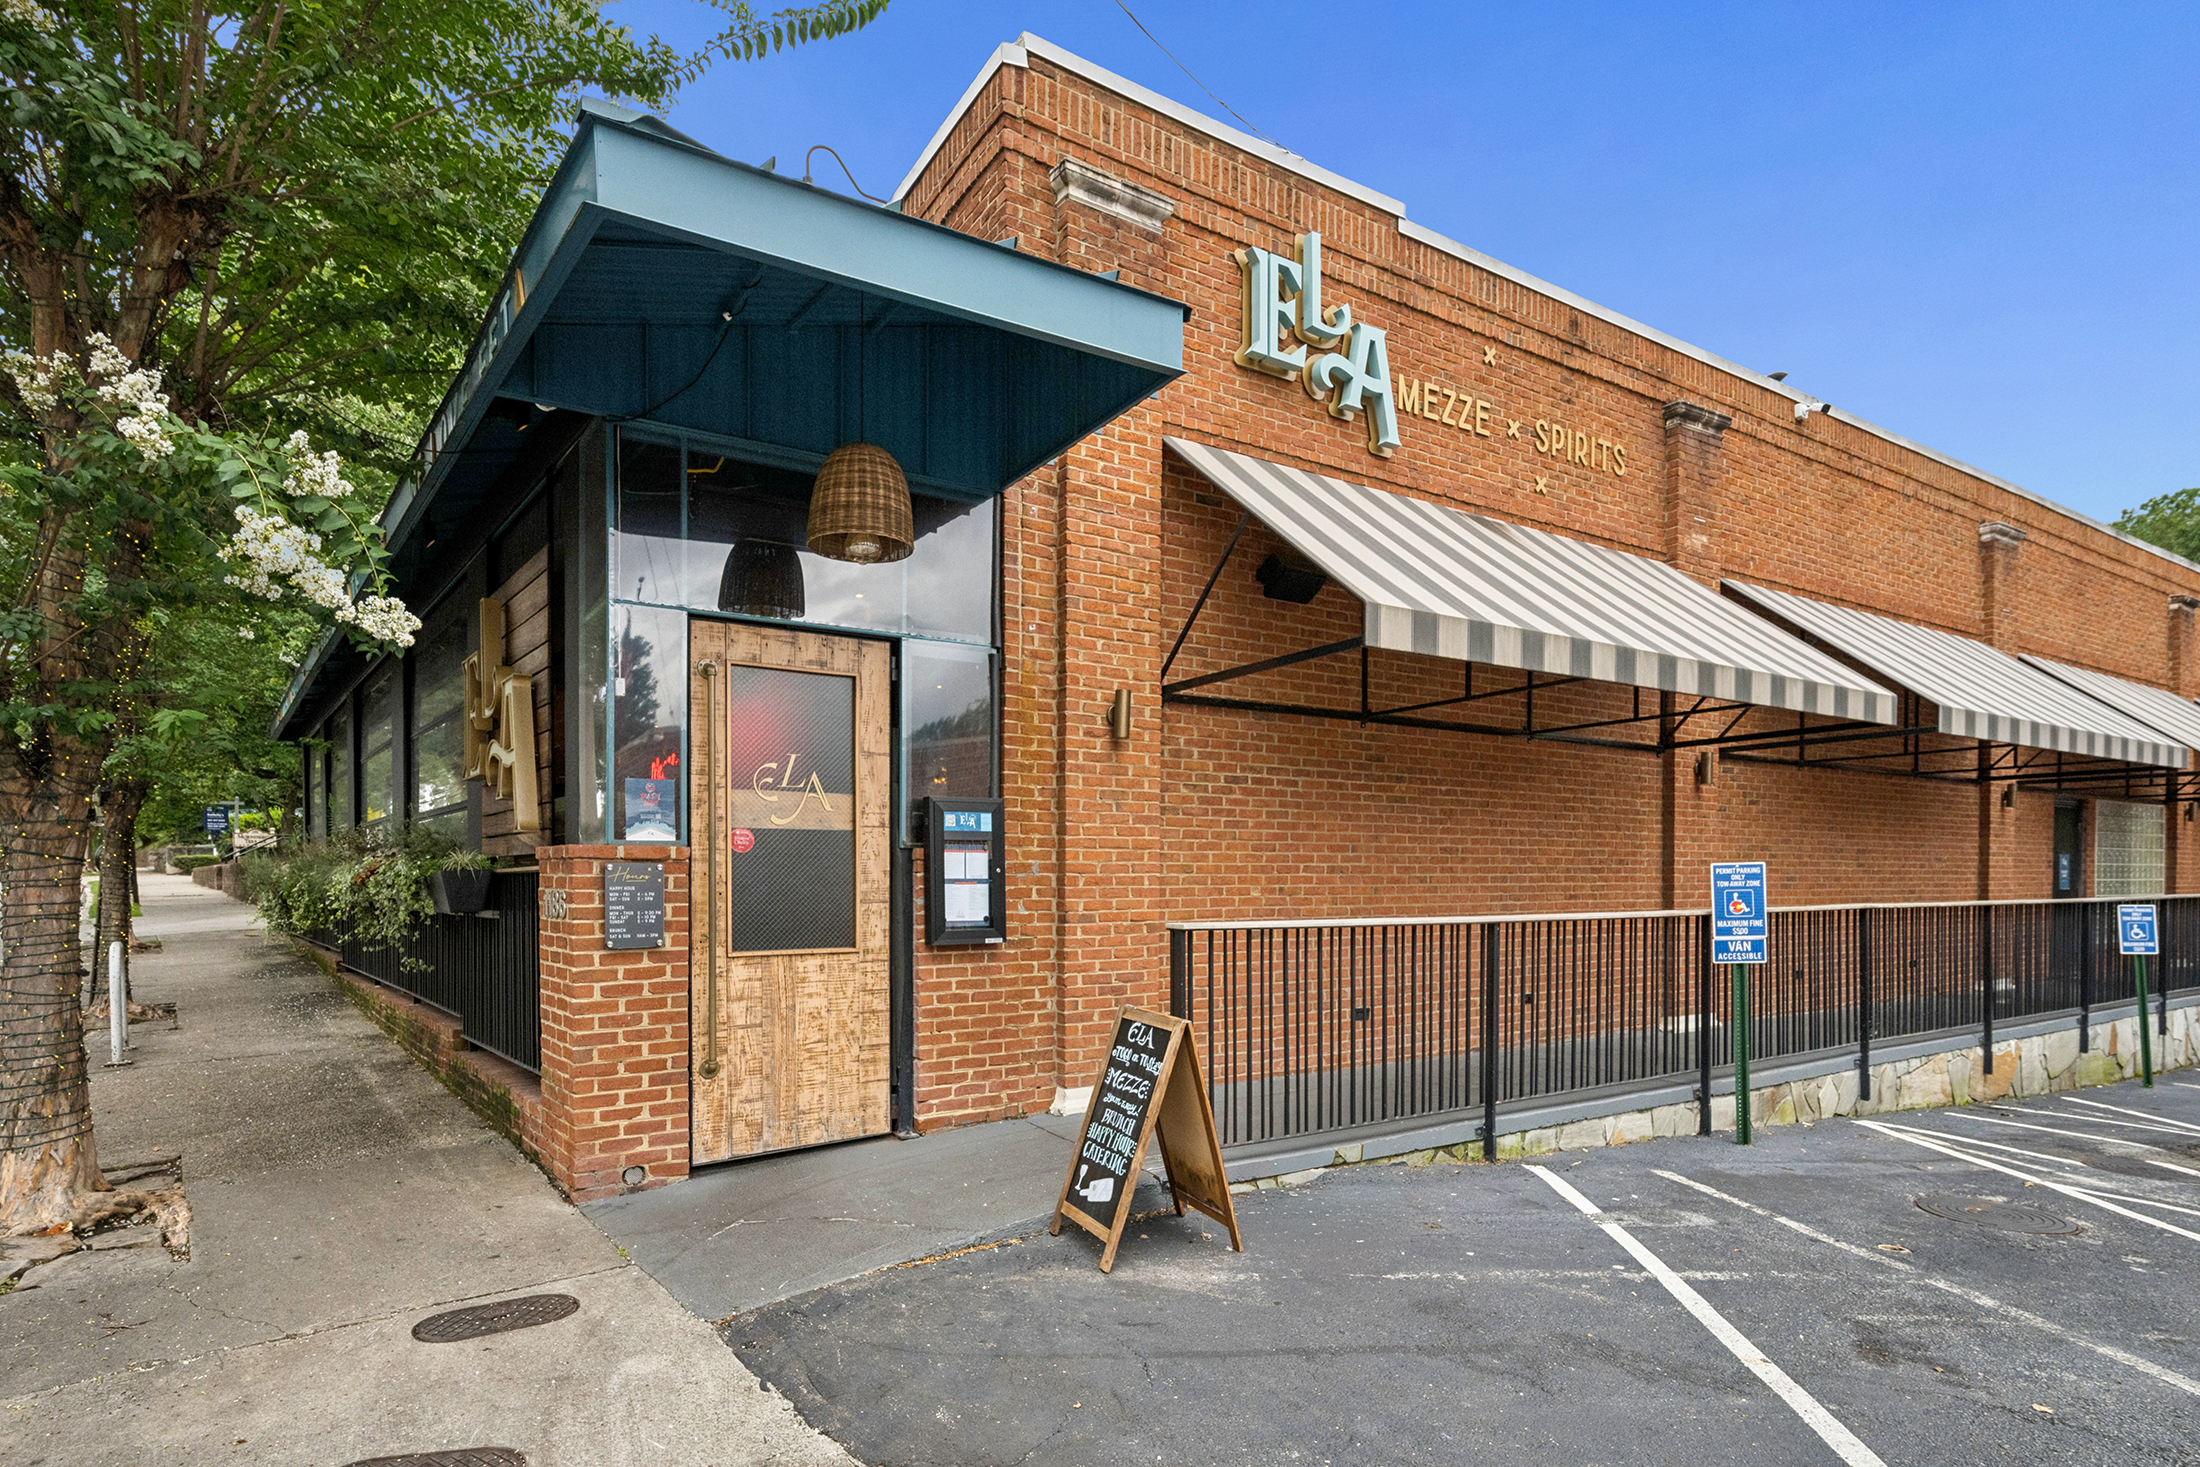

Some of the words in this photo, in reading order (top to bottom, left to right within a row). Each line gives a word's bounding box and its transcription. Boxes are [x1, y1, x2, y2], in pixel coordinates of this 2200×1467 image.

[1236, 231, 1402, 457] ELA
[1397, 374, 1491, 437] MEZZE
[1535, 418, 1626, 477] SPIRITS
[461, 597, 540, 833] ELA
[753, 753, 834, 825] ELA
[608, 866, 651, 882] Hours
[1750, 919, 1764, 927] FINE
[1718, 952, 1762, 960] ACCESSIBLE
[1728, 941, 1752, 952] VAN
[1127, 1021, 1155, 1049] ELA
[1108, 1066, 1149, 1099] MEZZE
[1101, 1108, 1137, 1136] BRUNCH
[1089, 1122, 1117, 1148] HAPPY
[1112, 1132, 1135, 1158] HOUR
[1082, 1140, 1128, 1176] CATERING
